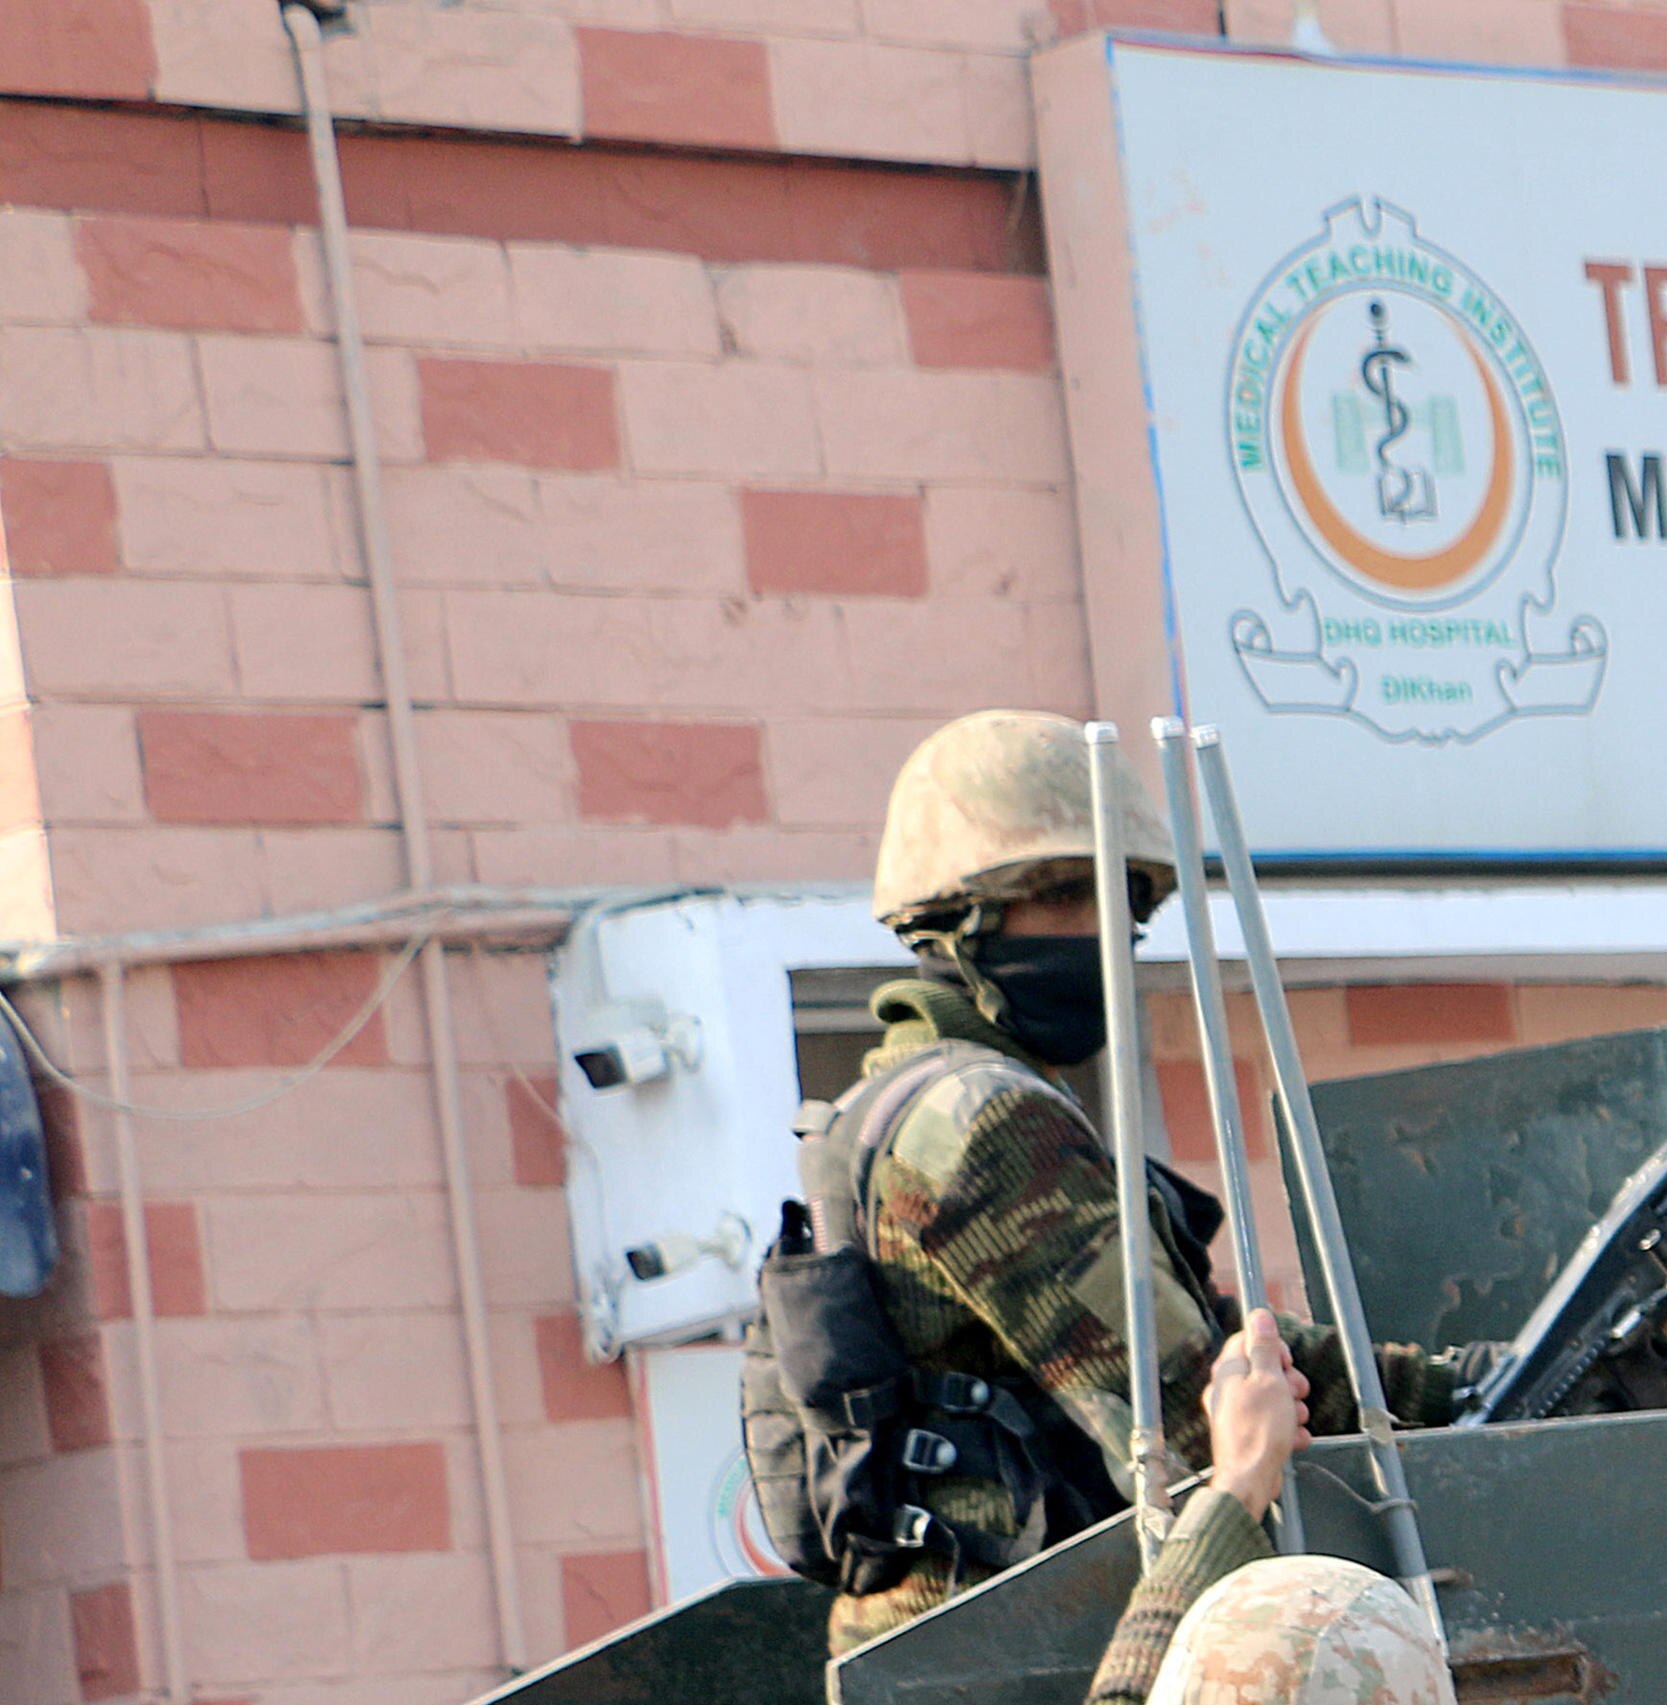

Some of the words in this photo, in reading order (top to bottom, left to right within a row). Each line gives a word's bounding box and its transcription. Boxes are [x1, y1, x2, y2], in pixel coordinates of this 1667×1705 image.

[1235, 301, 1290, 469] MEDICAL
[1286, 245, 1454, 299] TEACHING
[1461, 287, 1562, 478] INSTITUTE
[1324, 617, 1382, 645] DHQ
[1389, 617, 1517, 646] HOSPITAL
